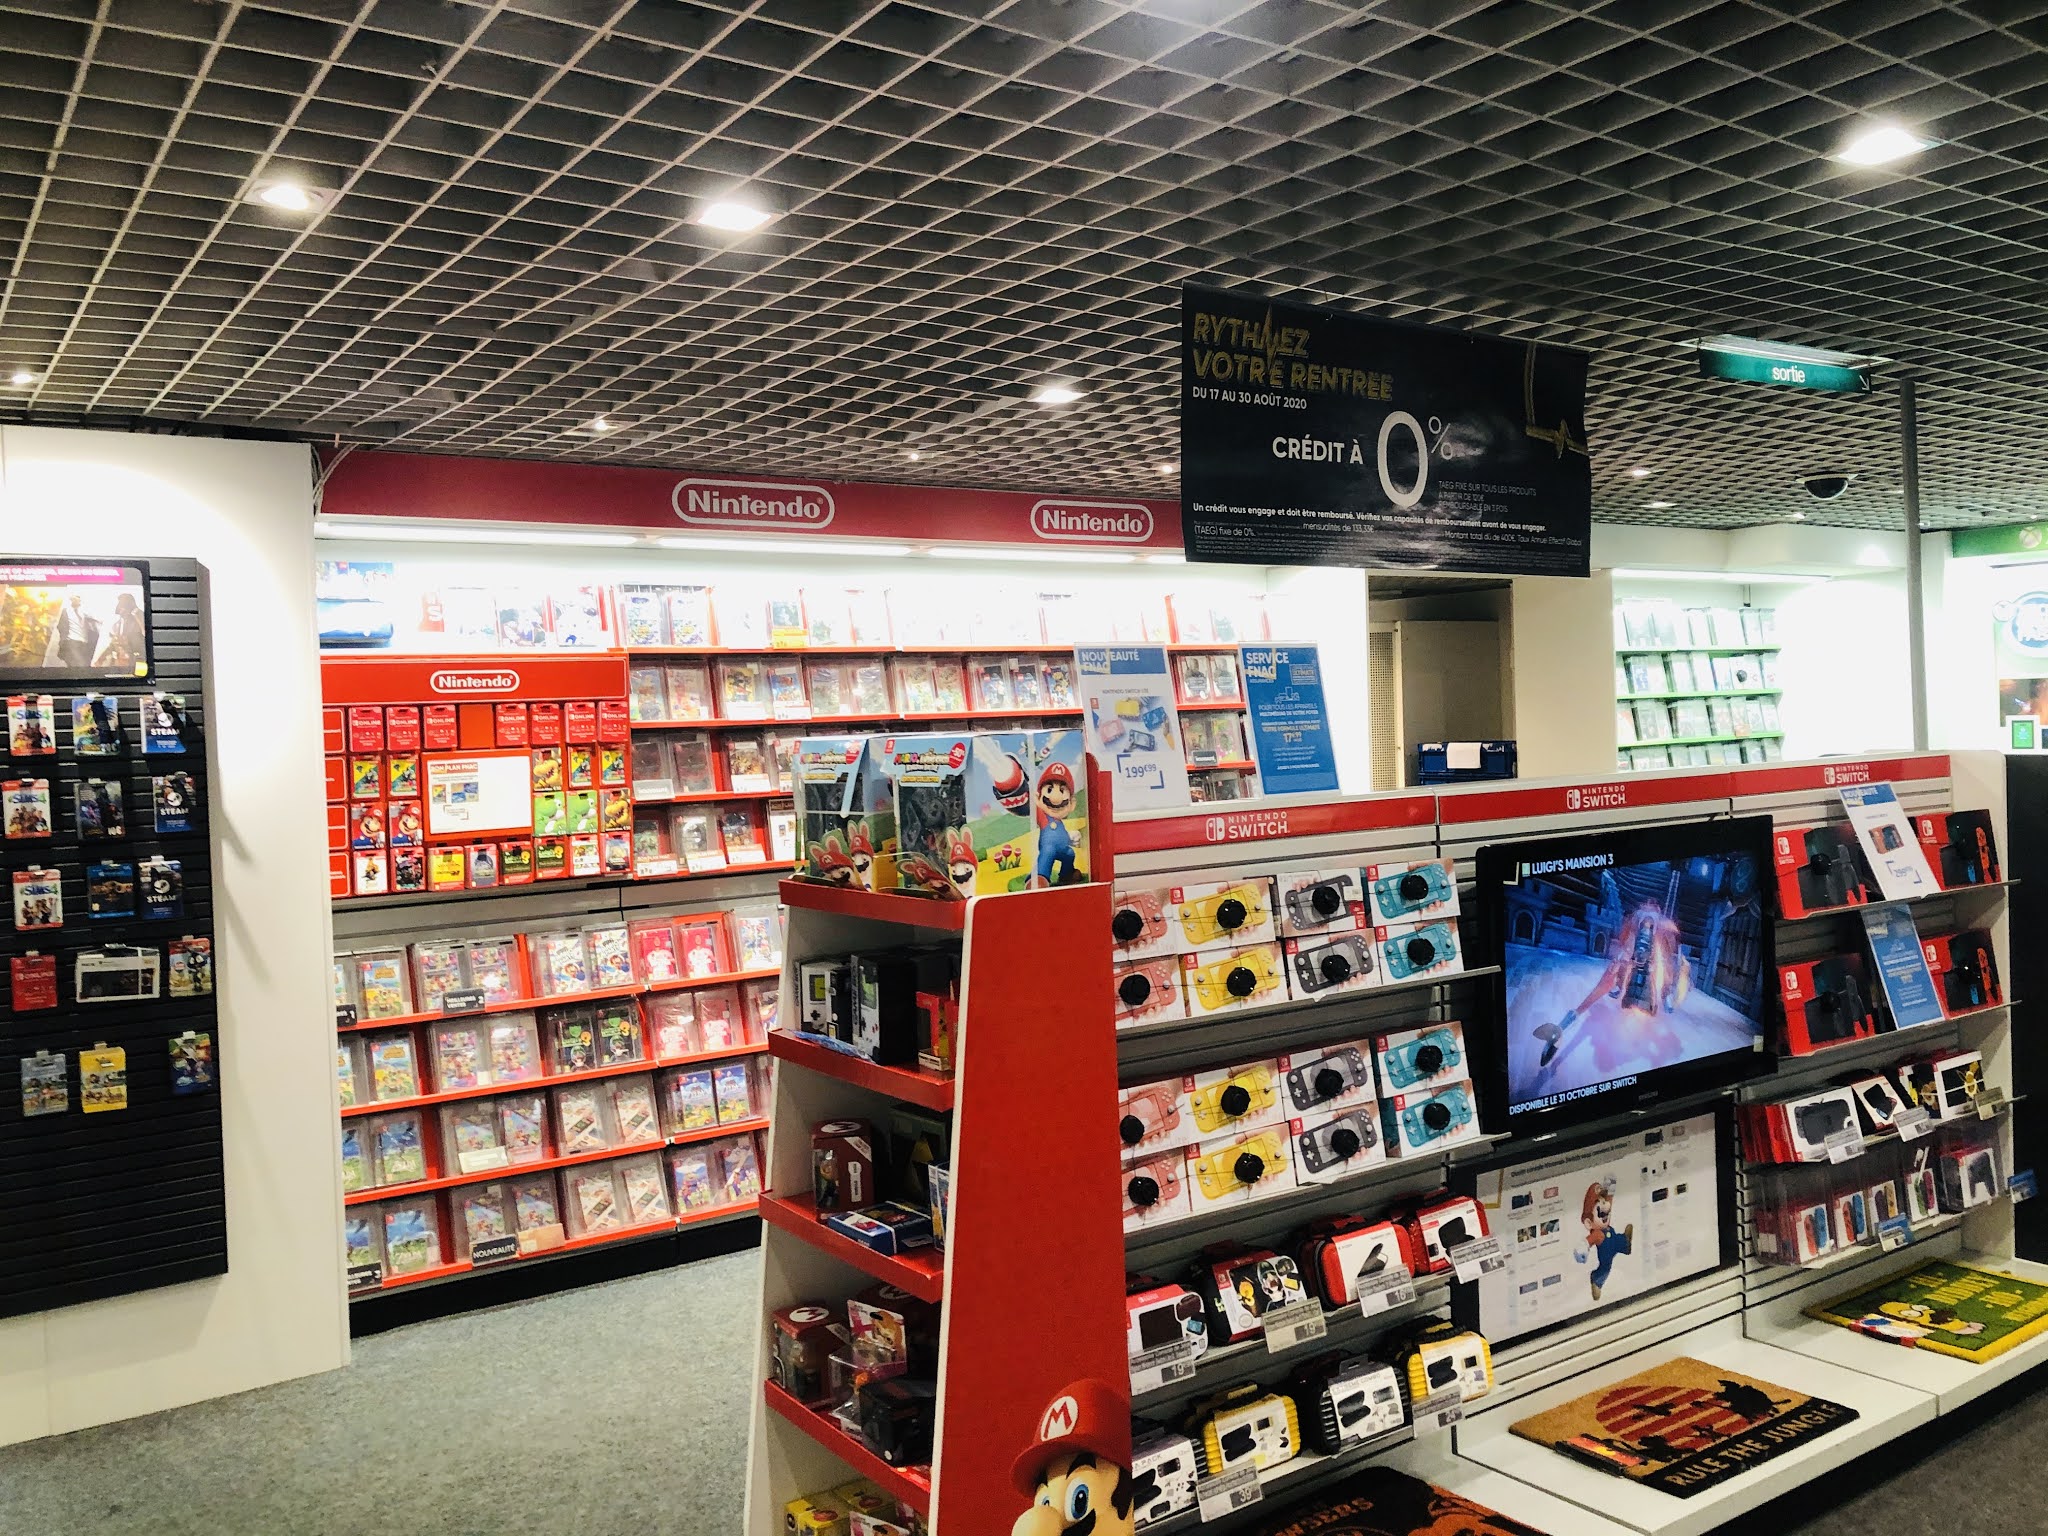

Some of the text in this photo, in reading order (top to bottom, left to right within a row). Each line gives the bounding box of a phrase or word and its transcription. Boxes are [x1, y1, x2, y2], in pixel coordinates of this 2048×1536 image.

[1192, 347, 1284, 388] VOTRE
[1772, 366, 1806, 383] sortie
[1193, 386, 1308, 410] DU 17 AU 30 AOÛT 2020
[1272, 434, 1345, 463] CRÉDIT
[1349, 438, 1364, 465] À
[1508, 485, 1537, 496] PRODUITS
[688, 489, 821, 519] Nintendo
[1041, 508, 1143, 533] Nintendo
[1193, 502, 1204, 512] Un
[1205, 503, 1228, 513] crédit
[1229, 506, 1246, 514] vous
[1248, 507, 1276, 518] engage
[1277, 507, 1286, 516] et
[1286, 508, 1301, 517] doit
[1302, 509, 1317, 519] être
[1355, 511, 1382, 522] Vérifiez
[1381, 514, 1393, 522] vos
[1393, 513, 1424, 525] capacités
[1424, 516, 1434, 525] de
[1434, 517, 1481, 529] remboursement
[1482, 519, 1499, 529] avant
[1500, 520, 1508, 530] de
[1508, 522, 1521, 531] vous
[1194, 525, 1218, 536] (TAEG)
[1219, 526, 1232, 537] fixe
[1232, 528, 1243, 537] de
[1302, 522, 1341, 532] mensualités
[1342, 524, 1352, 533] de
[1081, 649, 1140, 662] NOUVEAUTÉ
[1246, 652, 1290, 664] SERVICE
[1247, 665, 1277, 678] FNAC
[439, 675, 512, 688] Nintendo
[151, 728, 180, 736] STEAM
[1836, 764, 1869, 772] NINTENDO
[1836, 771, 1870, 783] SWITCH
[1582, 785, 1626, 795] NINTENDO
[1583, 793, 1626, 808] SWITCH
[160, 808, 189, 816] STEAM
[1228, 811, 1288, 823] NINTENDO
[1228, 820, 1289, 839] SWITCH
[1531, 853, 1614, 875] LUIGI'S MANSION 3
[147, 895, 177, 903] STEAM
[1509, 1075, 1637, 1115] DISPONIBLE LE 31 OCTOBRE SUR SWITCH
[473, 1244, 516, 1260] NOUVEAUTÉ
[1664, 1403, 1840, 1487] RULE THE JUNGLE
